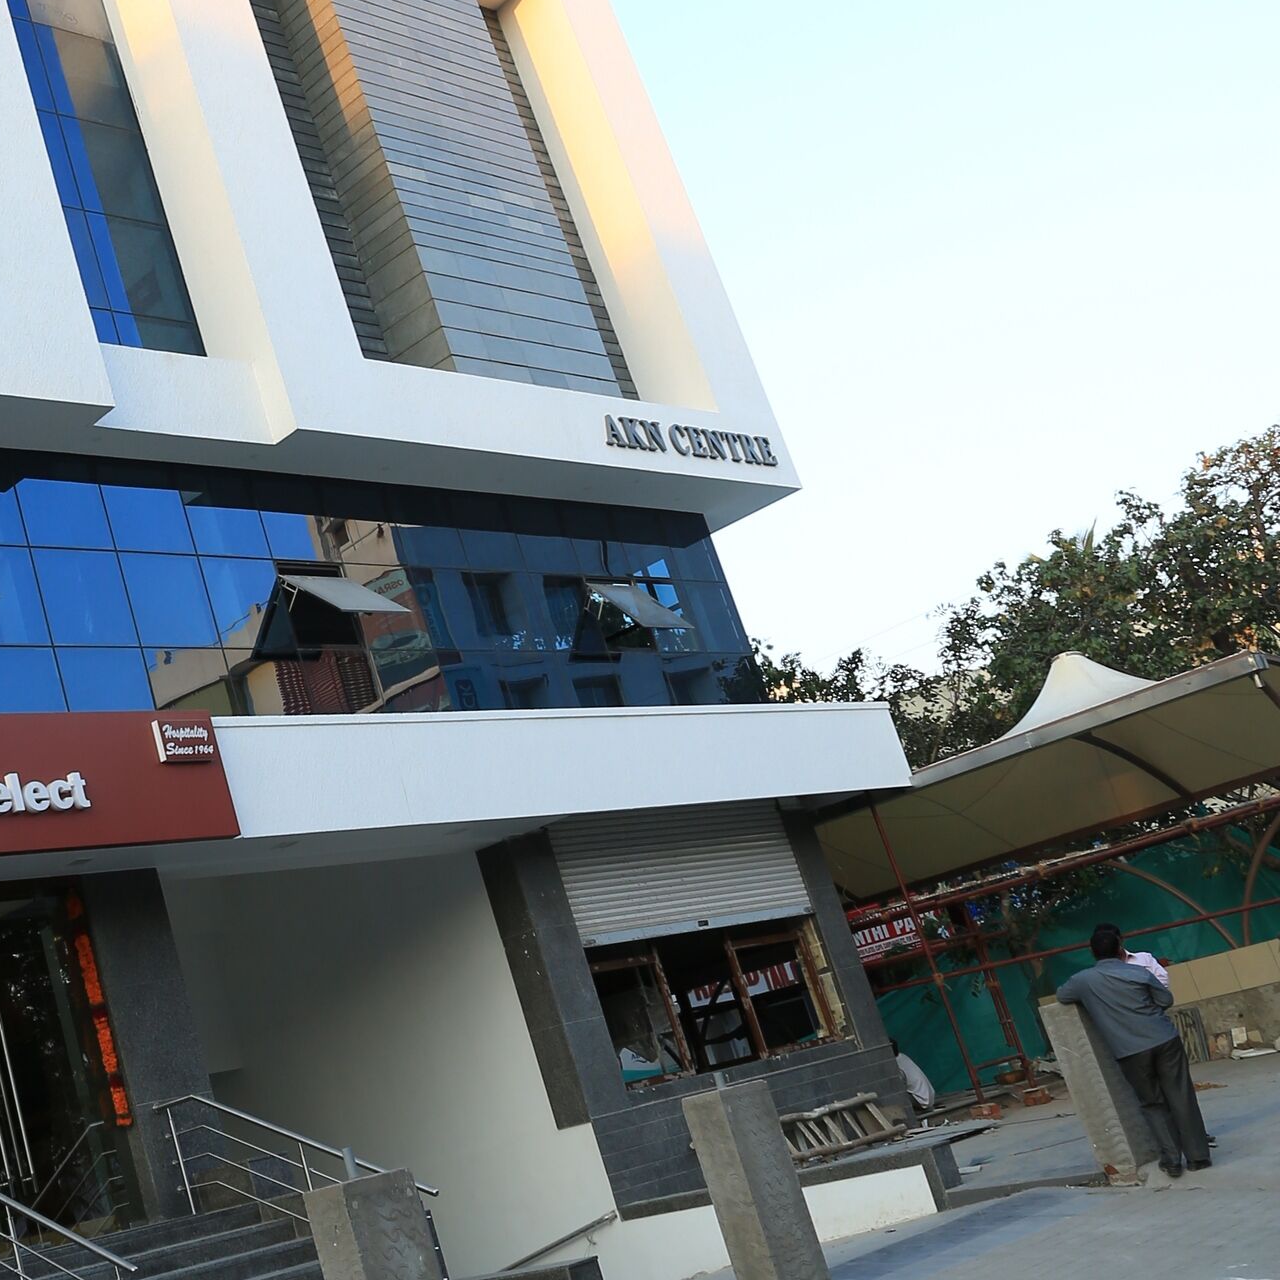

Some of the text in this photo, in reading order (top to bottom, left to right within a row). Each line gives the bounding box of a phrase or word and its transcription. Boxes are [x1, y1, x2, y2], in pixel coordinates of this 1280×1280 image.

[604, 414, 779, 467] AKN CENTRE
[162, 723, 208, 741] Hospitality
[166, 742, 214, 755] Since 1964
